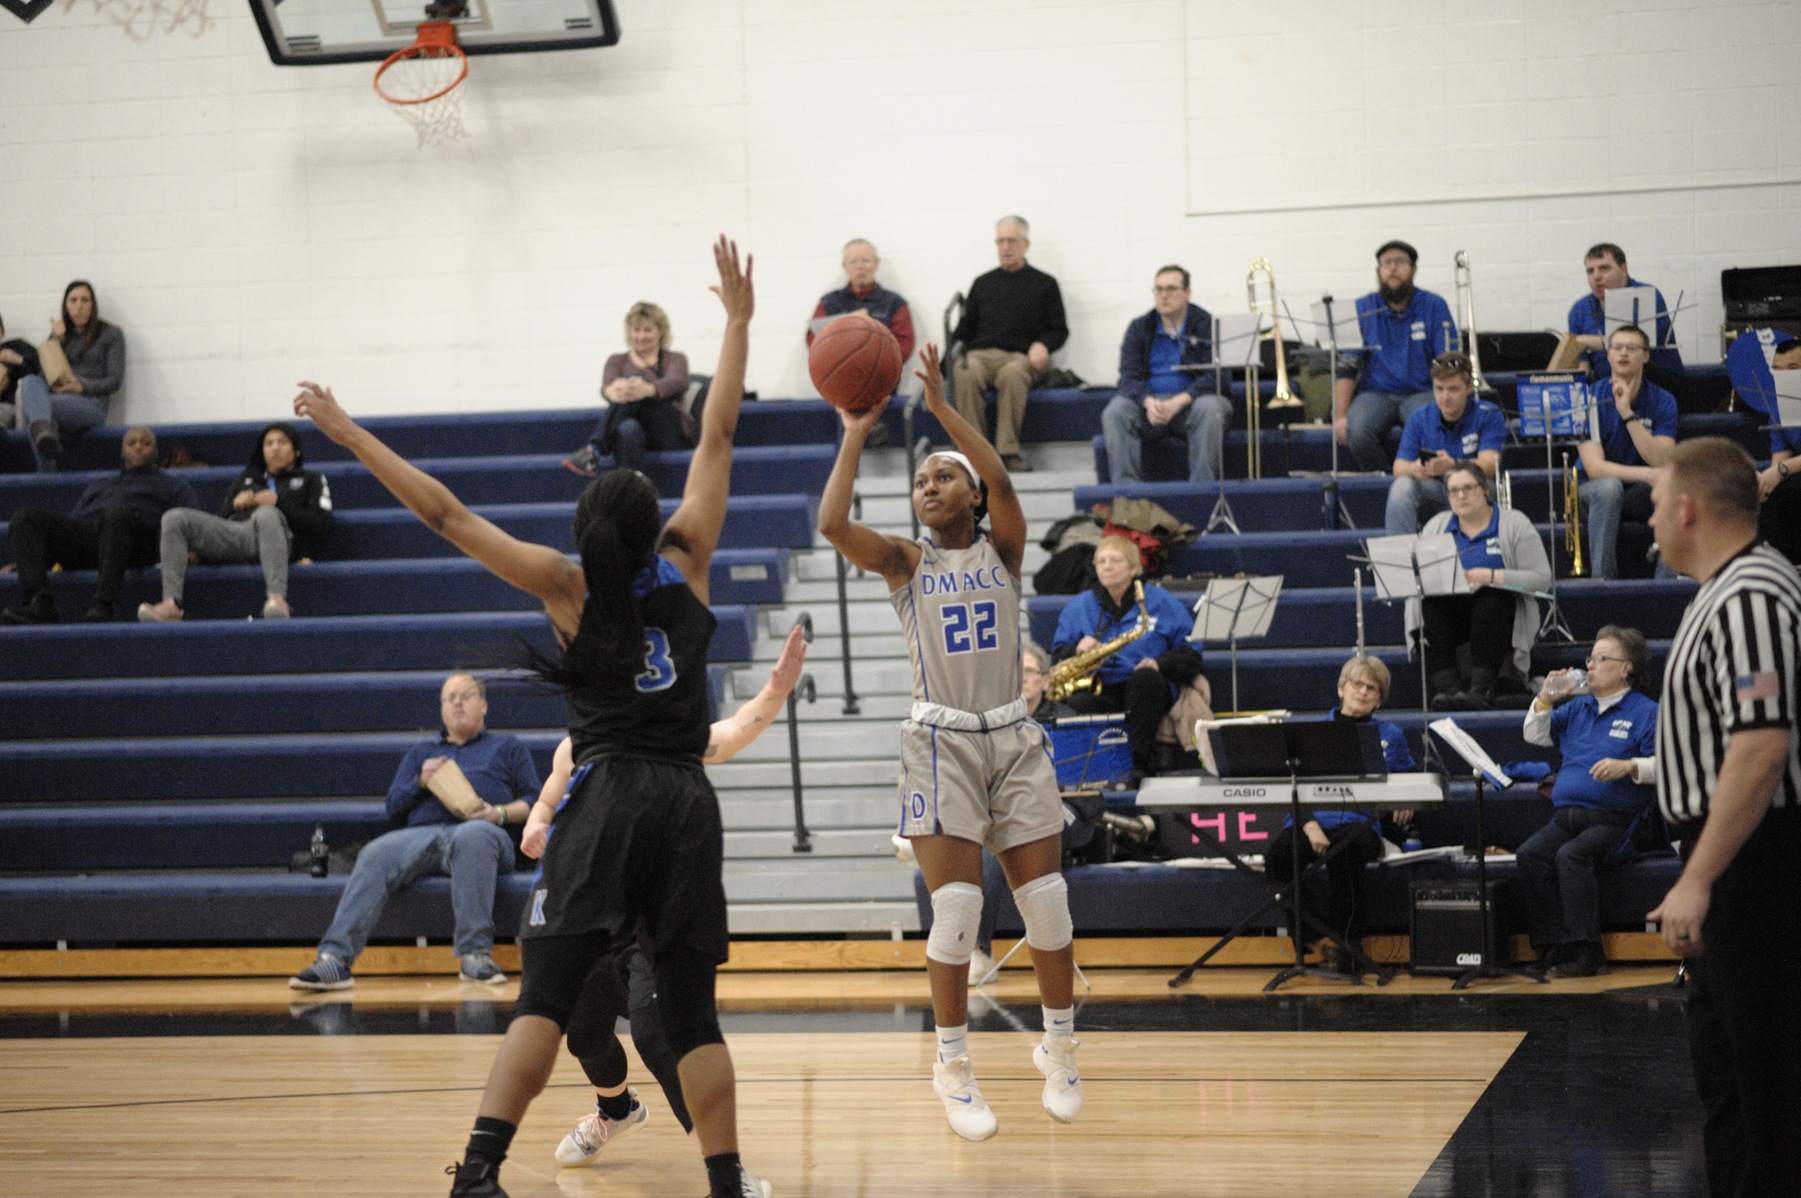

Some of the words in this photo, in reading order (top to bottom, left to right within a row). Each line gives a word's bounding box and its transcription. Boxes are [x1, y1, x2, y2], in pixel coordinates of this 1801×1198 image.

[922, 566, 1005, 596] DMACC
[940, 600, 999, 656] 22
[634, 626, 678, 693] 3
[911, 791, 927, 821] D
[1223, 788, 1266, 798] CASIO
[529, 888, 548, 927] K
